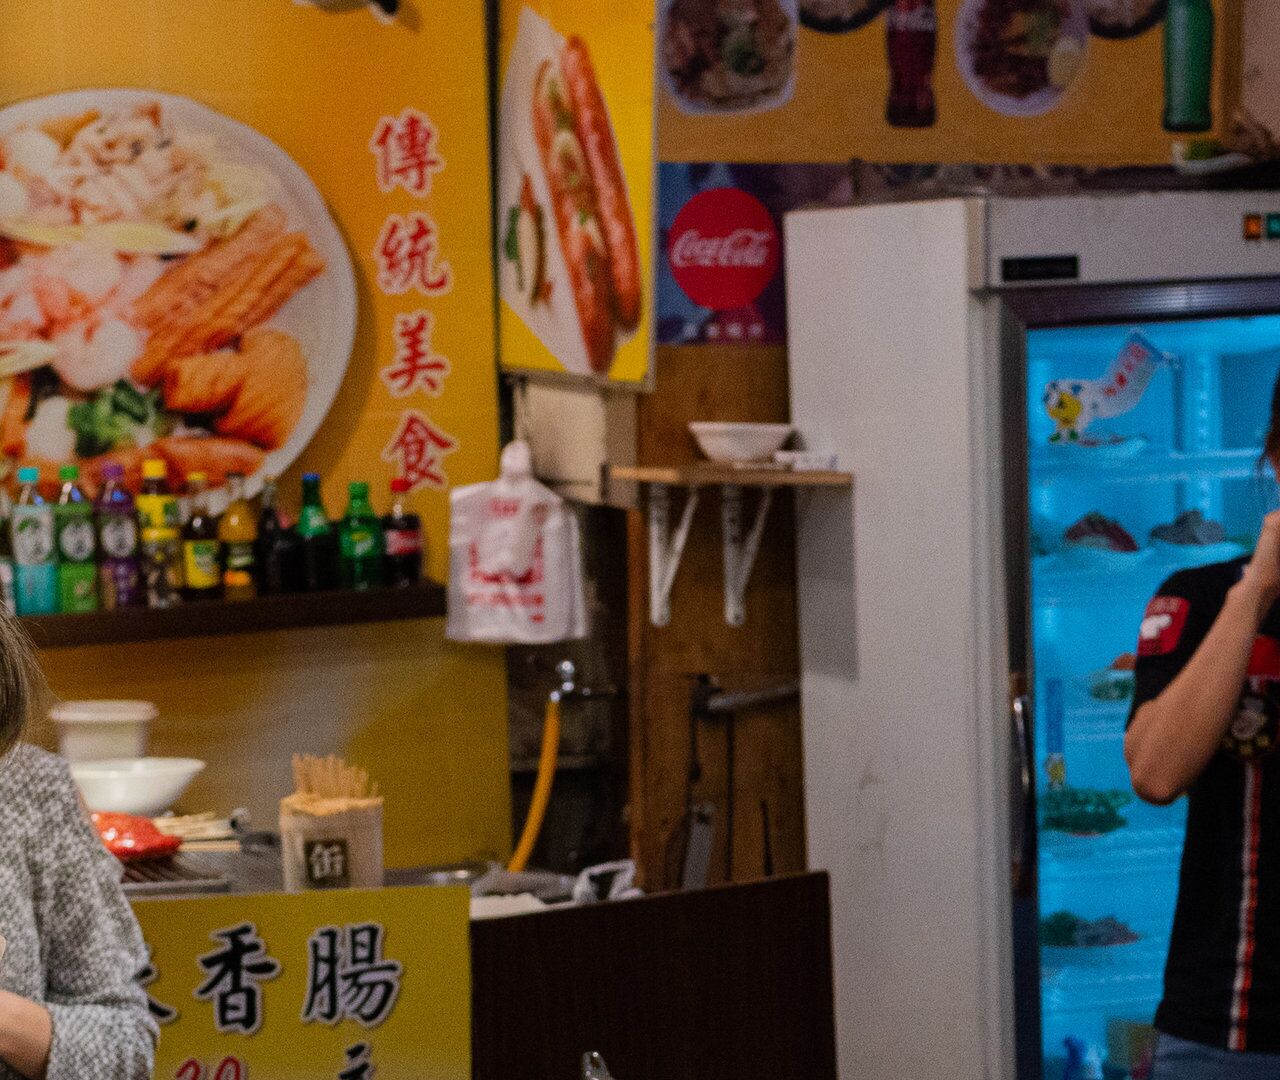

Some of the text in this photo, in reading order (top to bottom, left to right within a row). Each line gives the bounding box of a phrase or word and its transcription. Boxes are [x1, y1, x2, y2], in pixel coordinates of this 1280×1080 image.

[375, 115, 453, 485] 傳統美食
[132, 925, 398, 1027] 香腸
